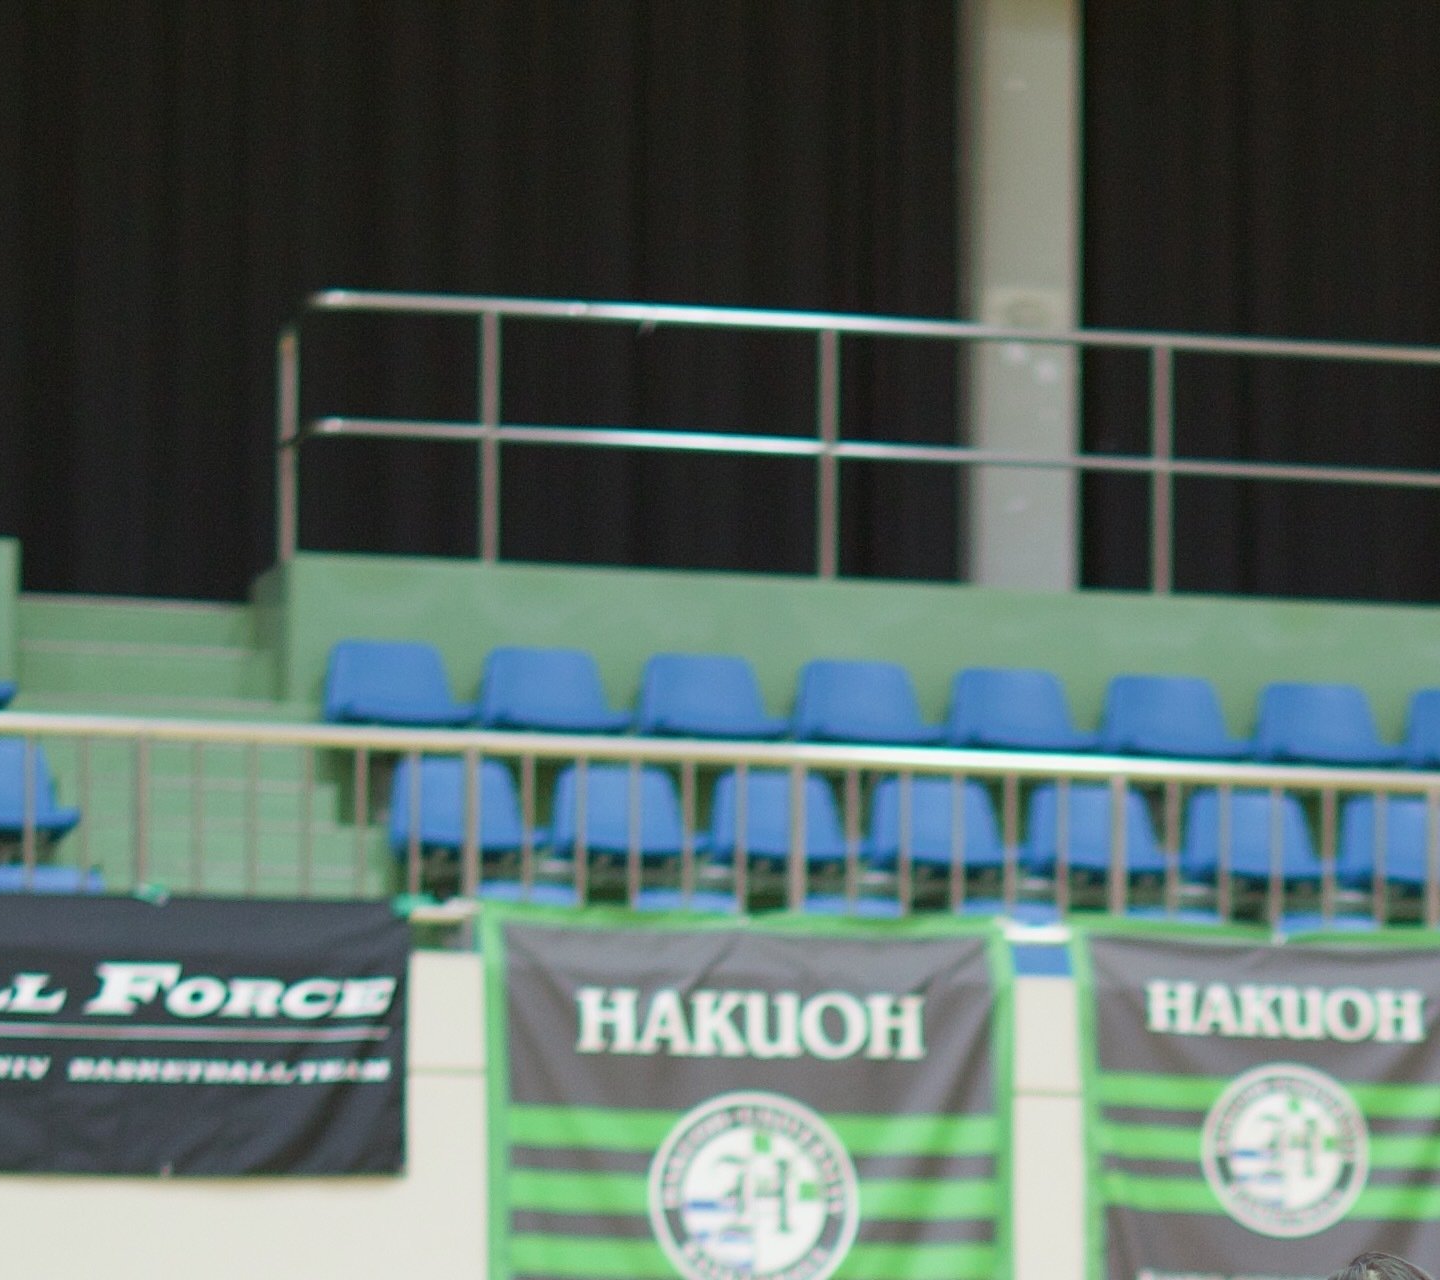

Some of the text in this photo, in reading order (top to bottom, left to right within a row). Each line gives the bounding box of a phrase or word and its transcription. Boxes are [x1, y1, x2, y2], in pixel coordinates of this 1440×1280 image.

[83, 962, 396, 1018] FORCE
[1145, 979, 1428, 1043] HAKUOH
[576, 986, 926, 1060] HAKUOH
